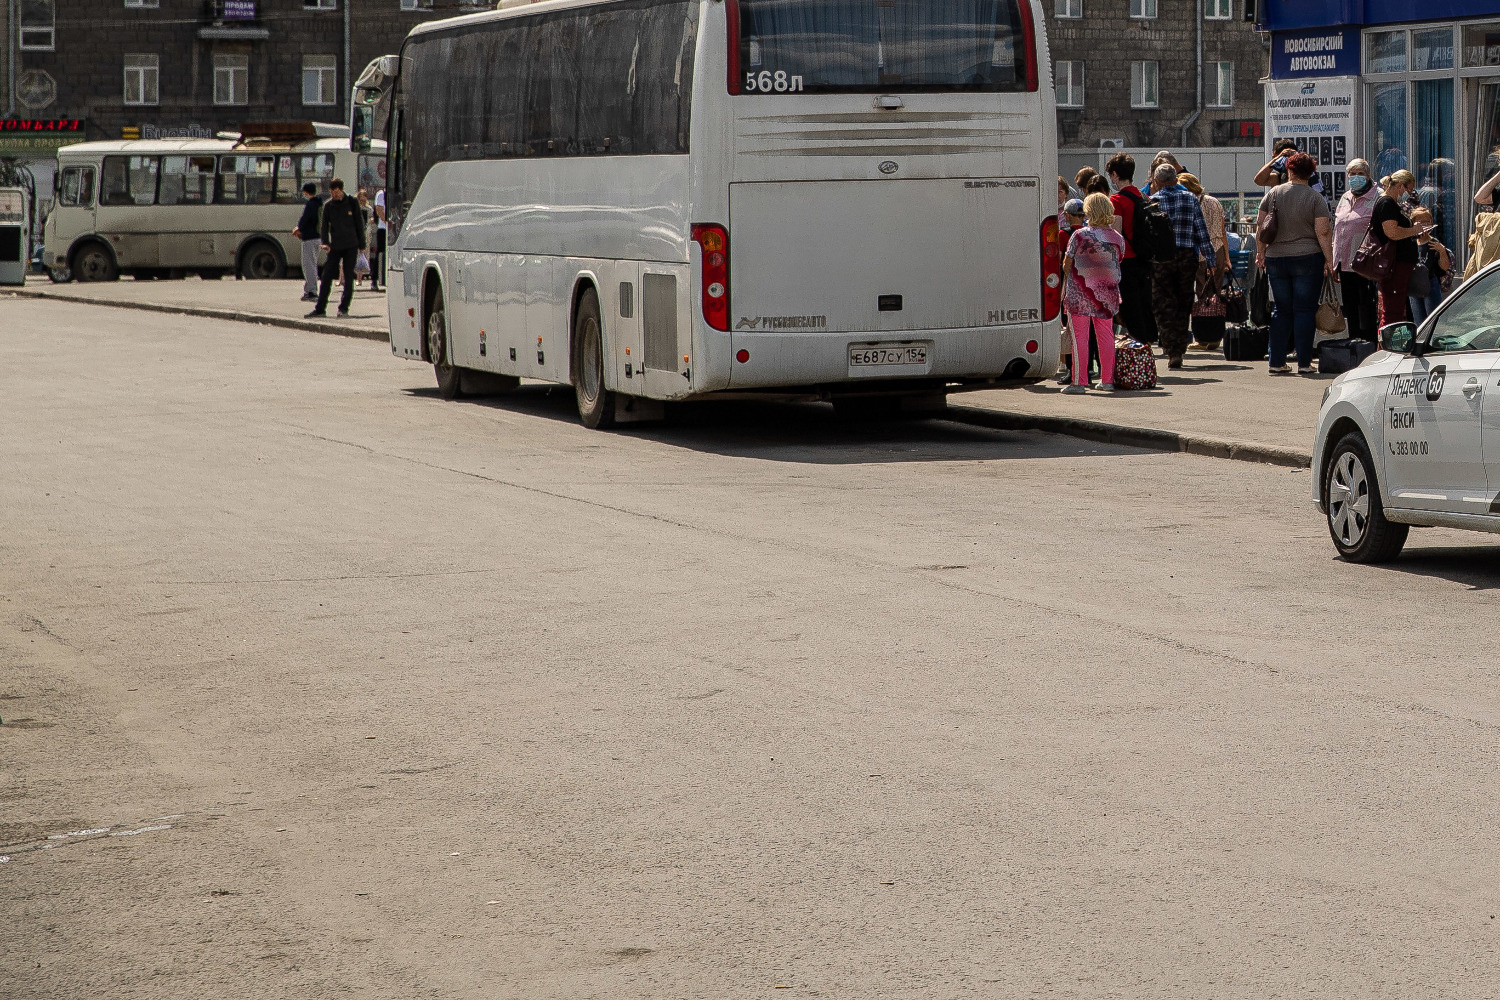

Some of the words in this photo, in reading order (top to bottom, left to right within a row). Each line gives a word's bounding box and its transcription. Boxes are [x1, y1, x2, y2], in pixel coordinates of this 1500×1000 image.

[1284, 32, 1344, 53] НОВОСИБИРСКИЙ
[1290, 55, 1336, 71] АВТОВОКЗАЛ
[745, 70, 804, 93] 568л
[142, 123, 212, 140] Билайн
[987, 308, 1039, 322] HIGER
[1390, 373, 1426, 398] Яндекс
[1428, 372, 1442, 393] Go
[1389, 407, 1415, 429] Такси
[1397, 441, 1408, 455] 383
[1410, 441, 1418, 455] 00
[1420, 441, 1429, 455] 00
